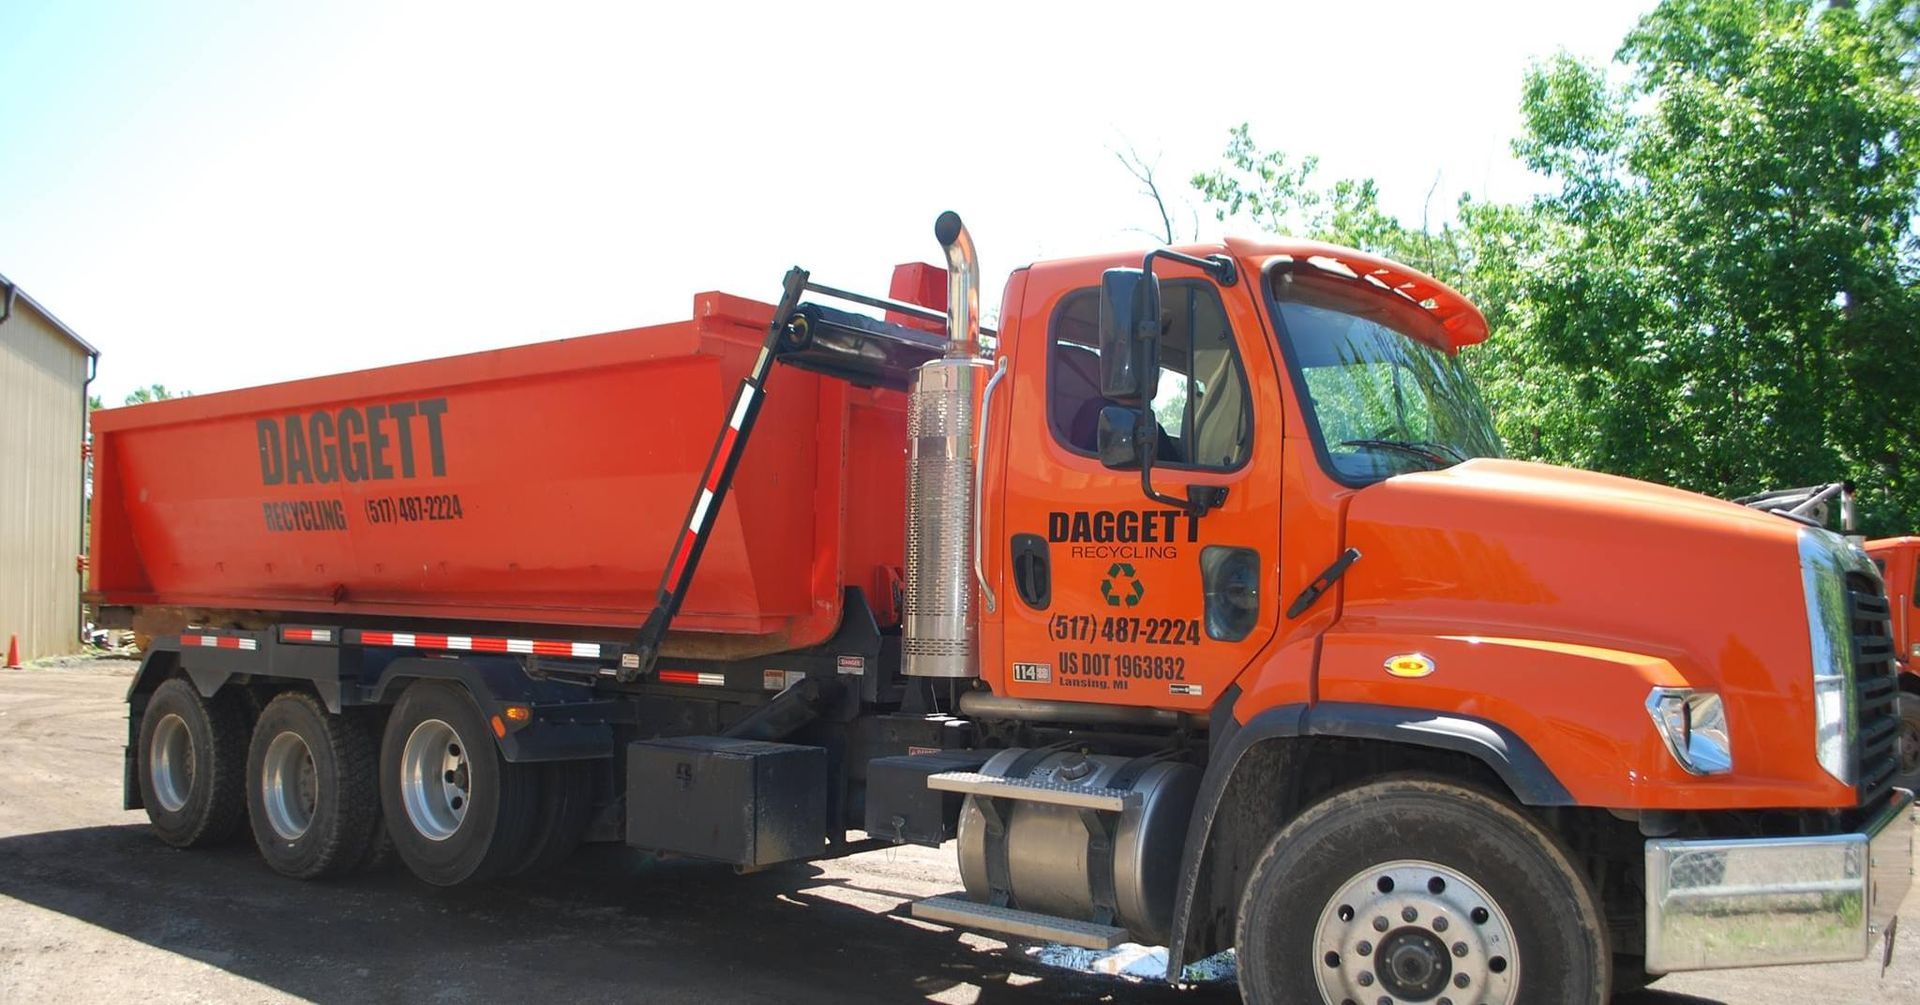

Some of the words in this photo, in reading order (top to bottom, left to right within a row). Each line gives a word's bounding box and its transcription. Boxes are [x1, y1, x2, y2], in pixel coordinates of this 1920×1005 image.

[256, 397, 448, 486] DAGGETT
[263, 500, 347, 531] RECYCLING
[365, 497, 398, 525] (517)
[399, 495, 463, 522] 487-2224
[1049, 510, 1202, 543] DAGGETT
[1072, 546, 1177, 559] RECYCLING
[1049, 613, 1097, 644] (517)
[1101, 617, 1200, 645] 487-2224
[1015, 665, 1035, 680] 114
[1059, 652, 1078, 674] US
[1082, 653, 1111, 677] DOT
[1114, 655, 1185, 680] 1963832
[1112, 681, 1128, 690] MI
